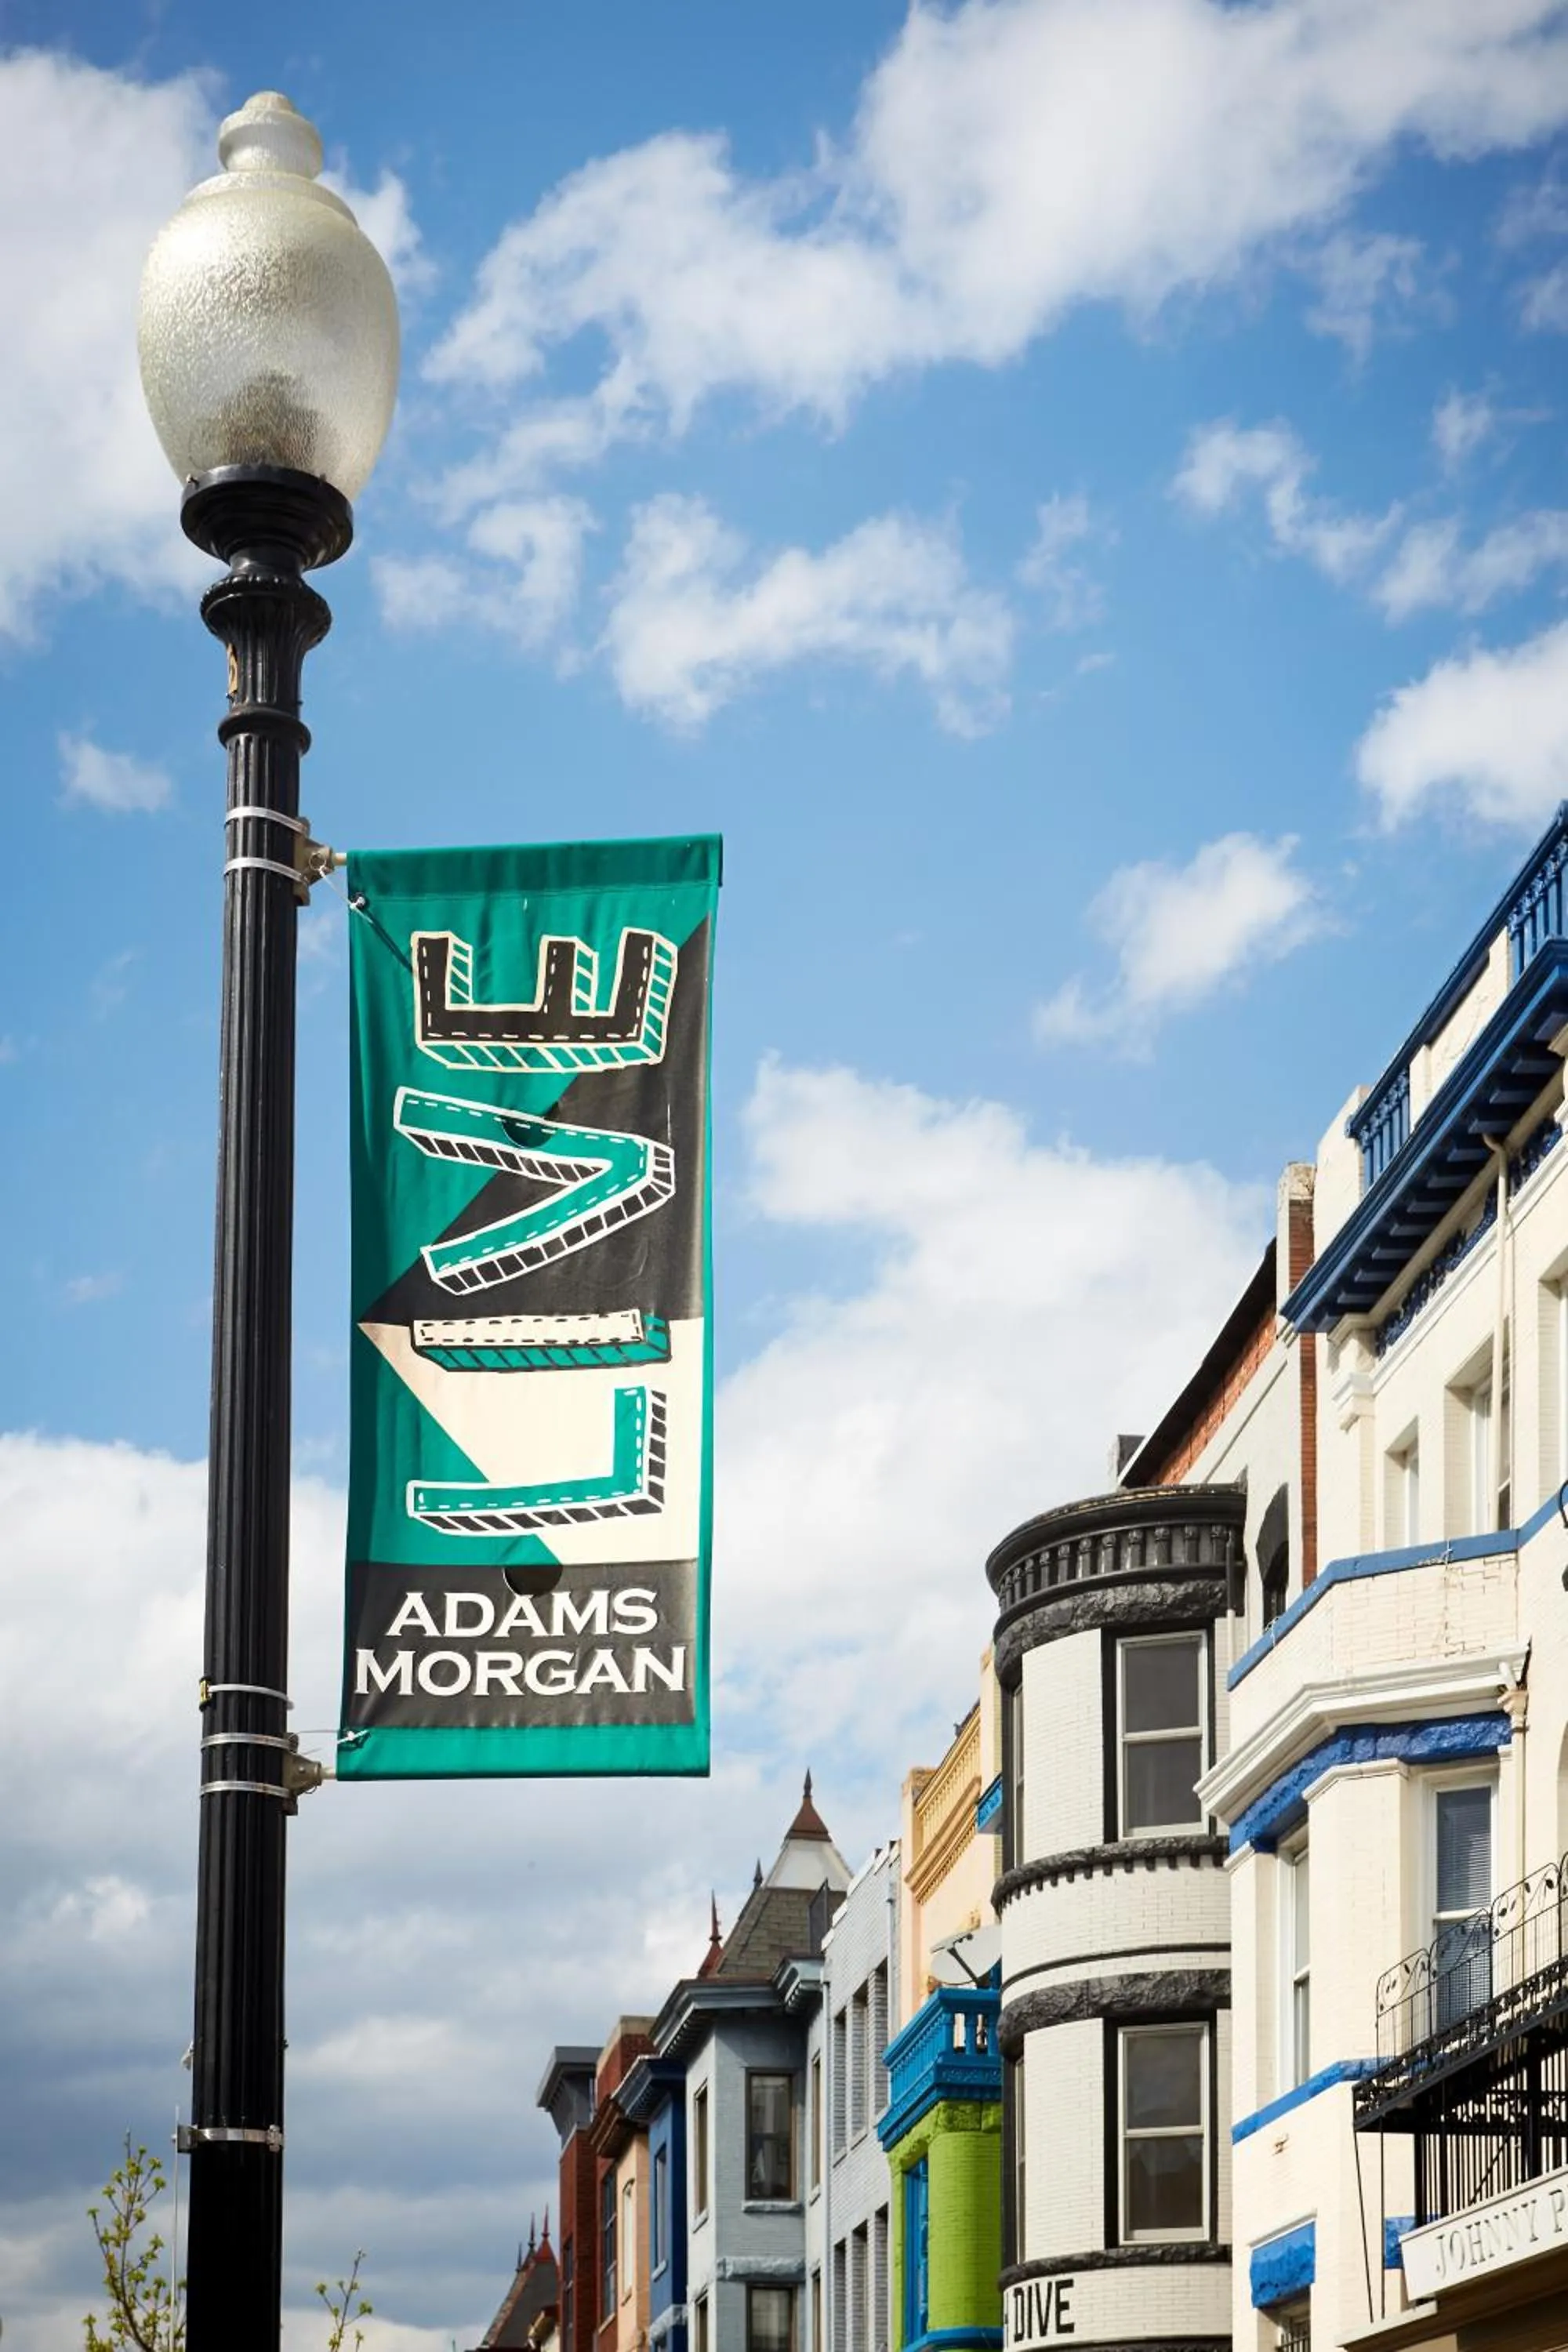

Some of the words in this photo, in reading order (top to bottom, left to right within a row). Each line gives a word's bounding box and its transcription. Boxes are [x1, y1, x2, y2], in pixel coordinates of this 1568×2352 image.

[394, 928, 678, 1537] LIVE
[385, 1588, 659, 1637] ADAMS
[354, 1646, 687, 1696] MORGAN
[1436, 2200, 1539, 2278] JOHNNY
[1014, 2279, 1074, 2342] DIVE
